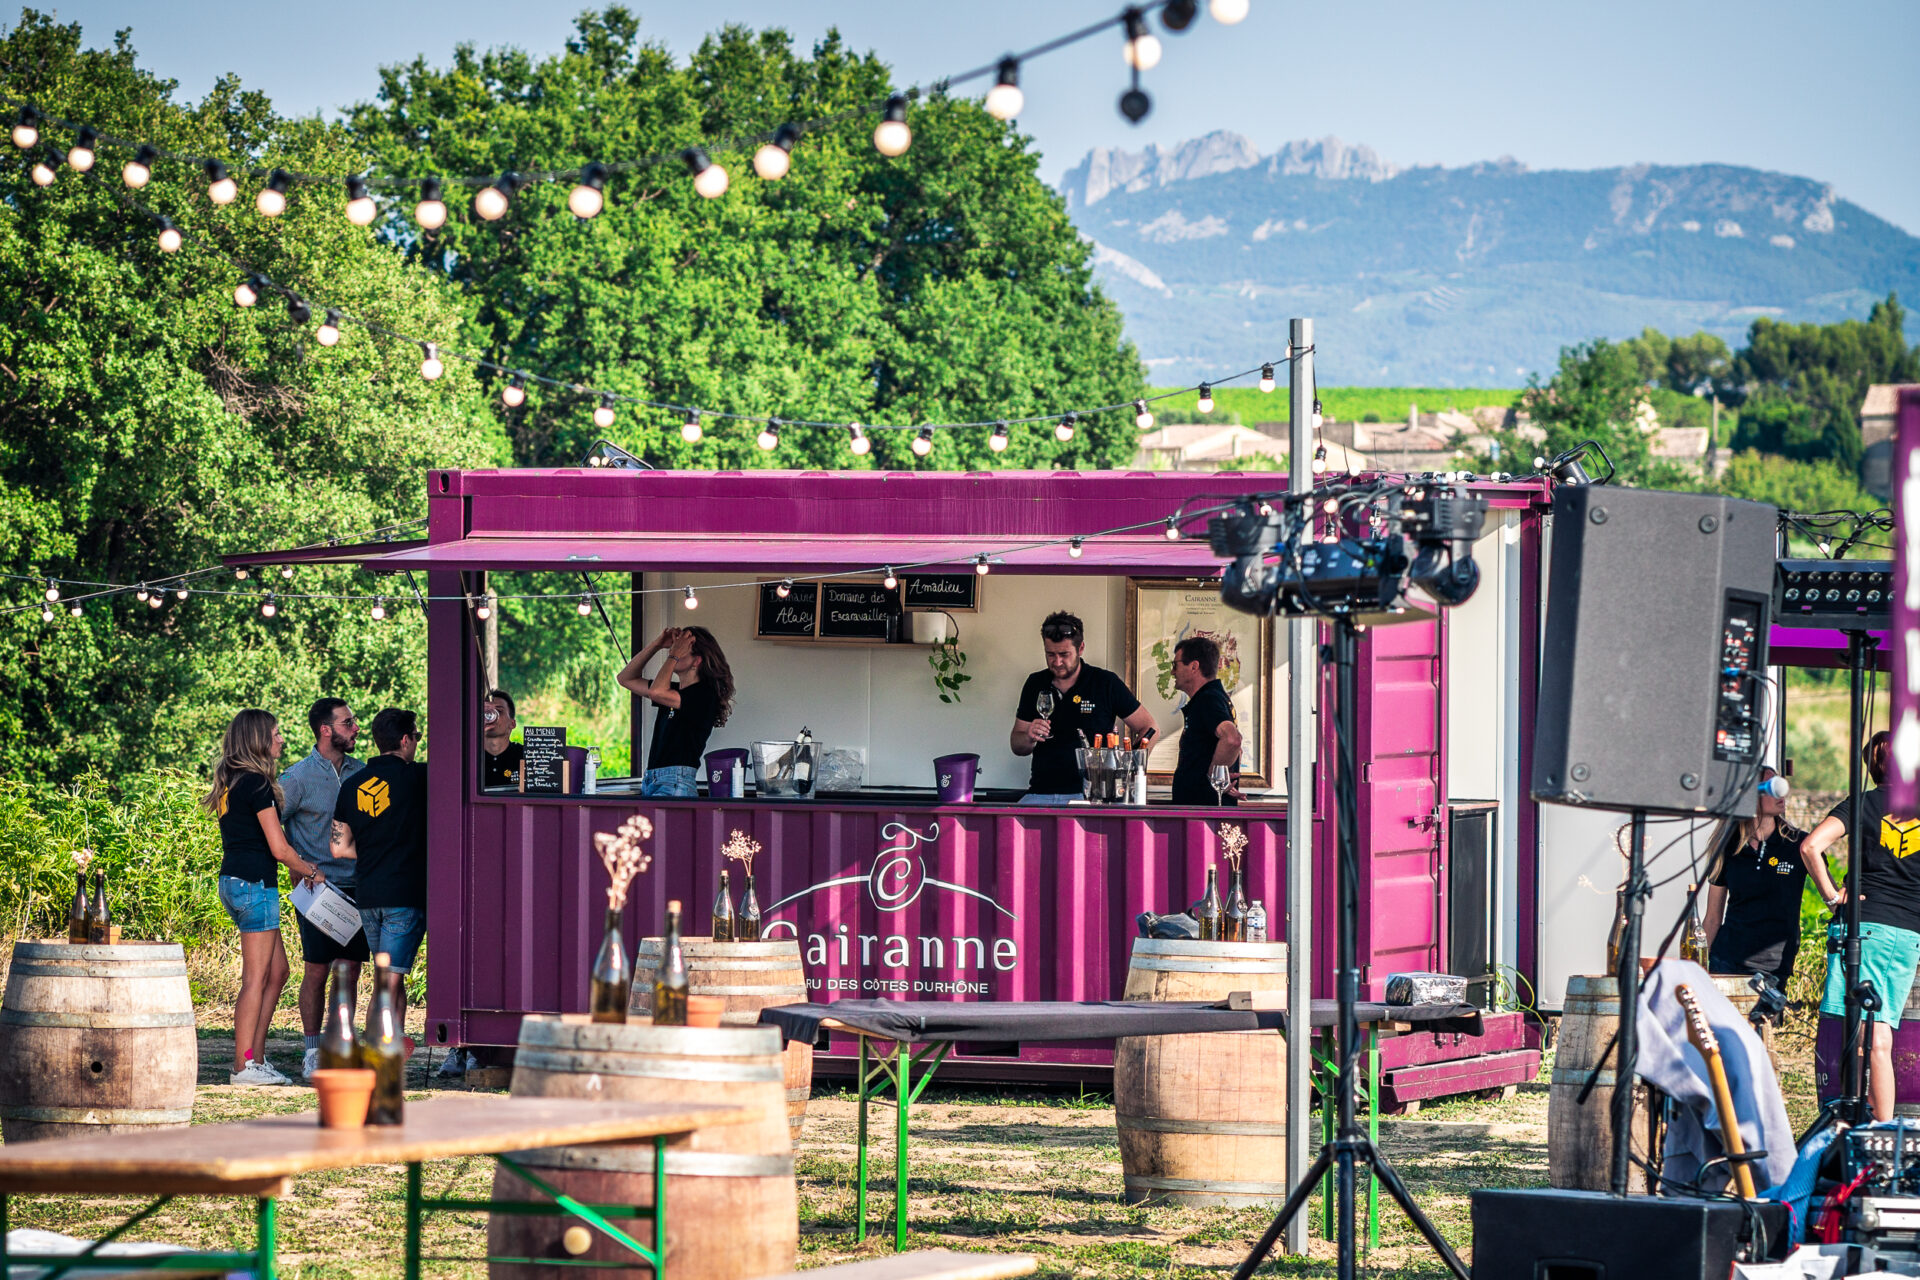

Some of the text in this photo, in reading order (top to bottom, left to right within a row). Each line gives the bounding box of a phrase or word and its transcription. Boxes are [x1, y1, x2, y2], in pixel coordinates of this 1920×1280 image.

[910, 579, 964, 595] Amadieu
[769, 590, 815, 602] Dmaine
[829, 590, 885, 603] Domaine des
[806, 979, 821, 990] RU
[827, 979, 858, 991] DES
[863, 979, 909, 992] CÔTES
